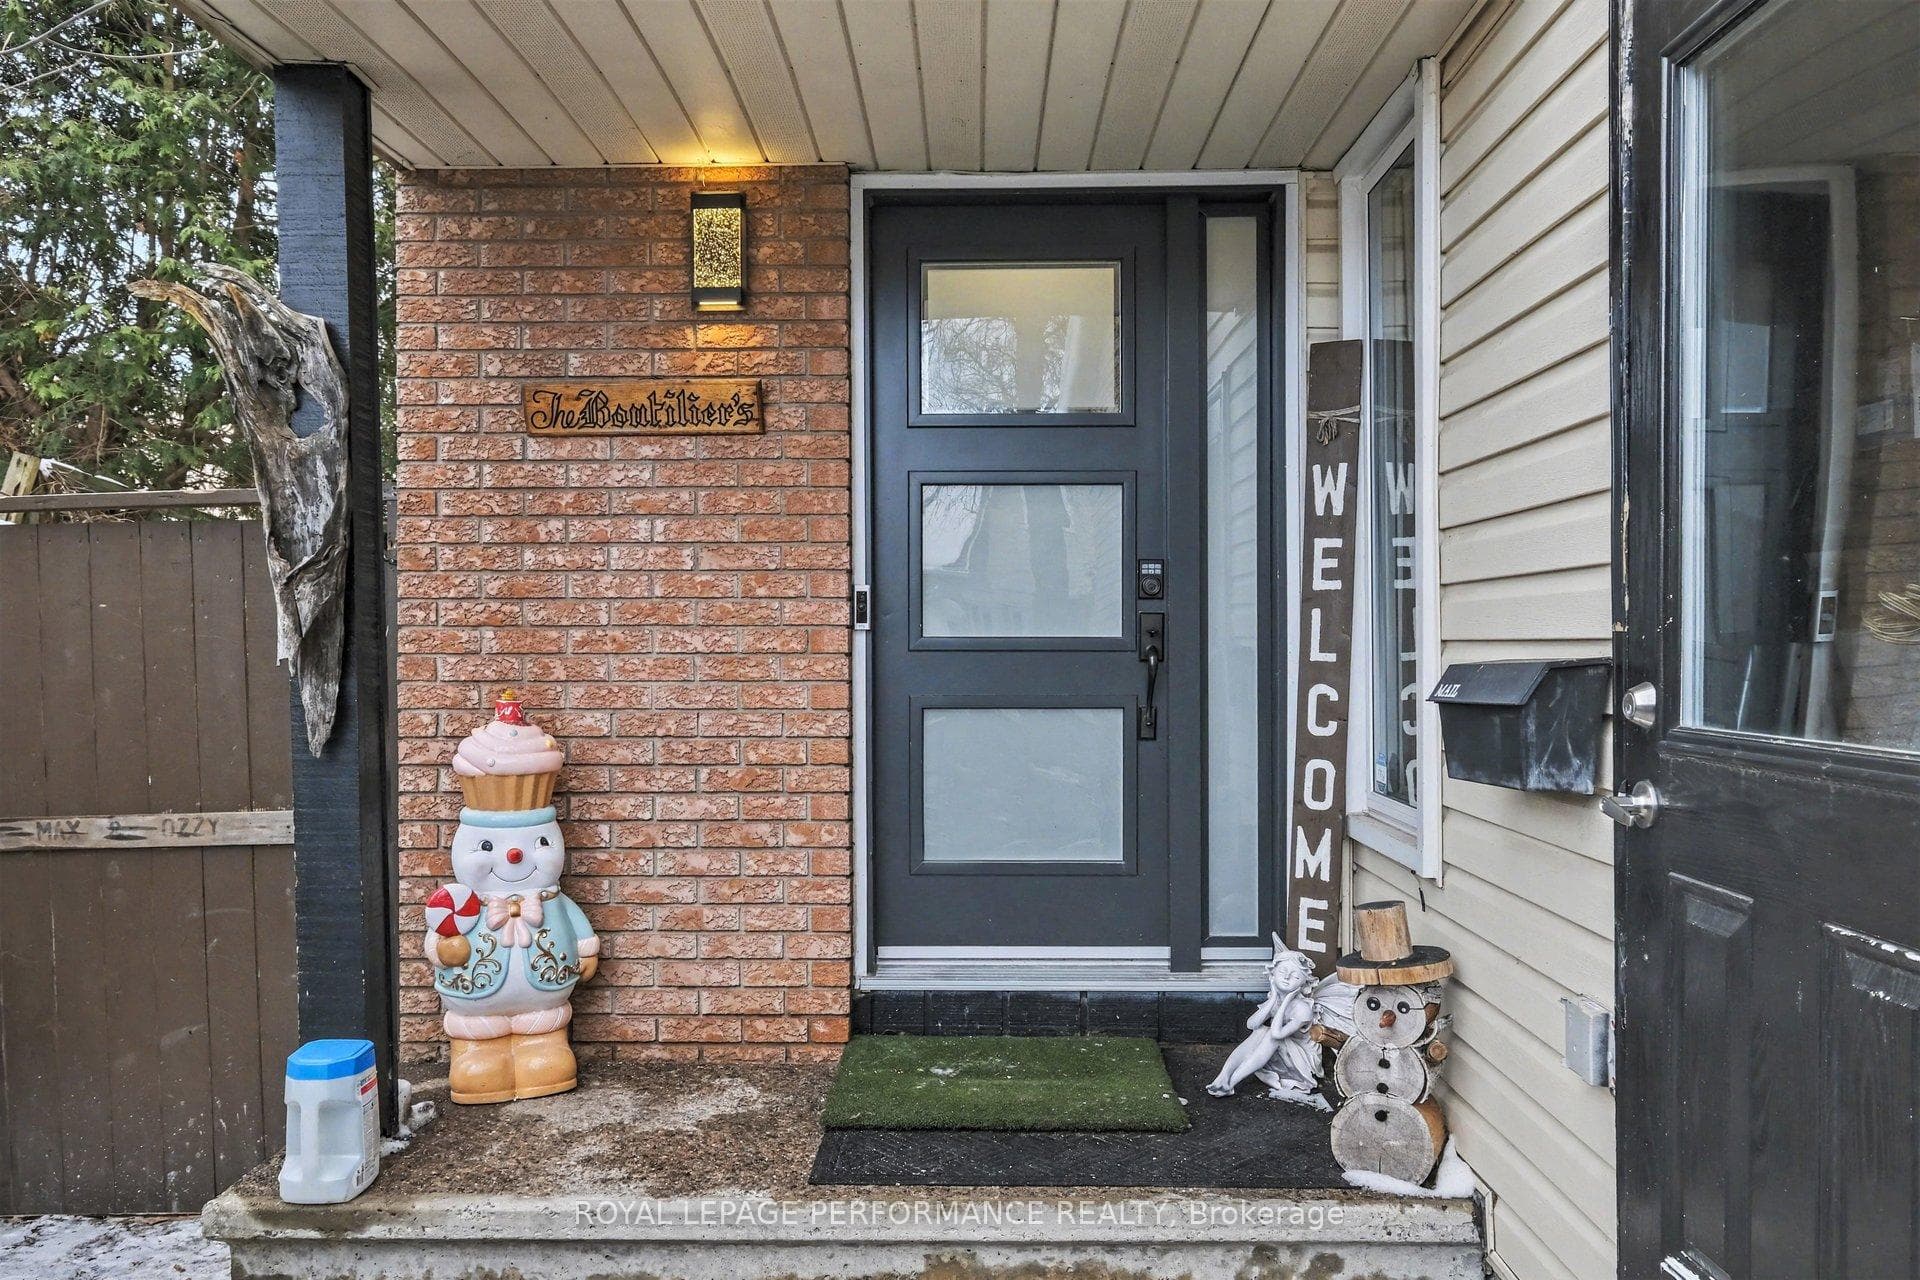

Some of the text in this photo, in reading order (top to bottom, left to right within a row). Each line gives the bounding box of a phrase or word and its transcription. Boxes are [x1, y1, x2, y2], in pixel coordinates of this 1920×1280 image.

[531, 390, 578, 429] The
[1295, 462, 1348, 953] WELCOME
[1434, 684, 1461, 698] MAIL
